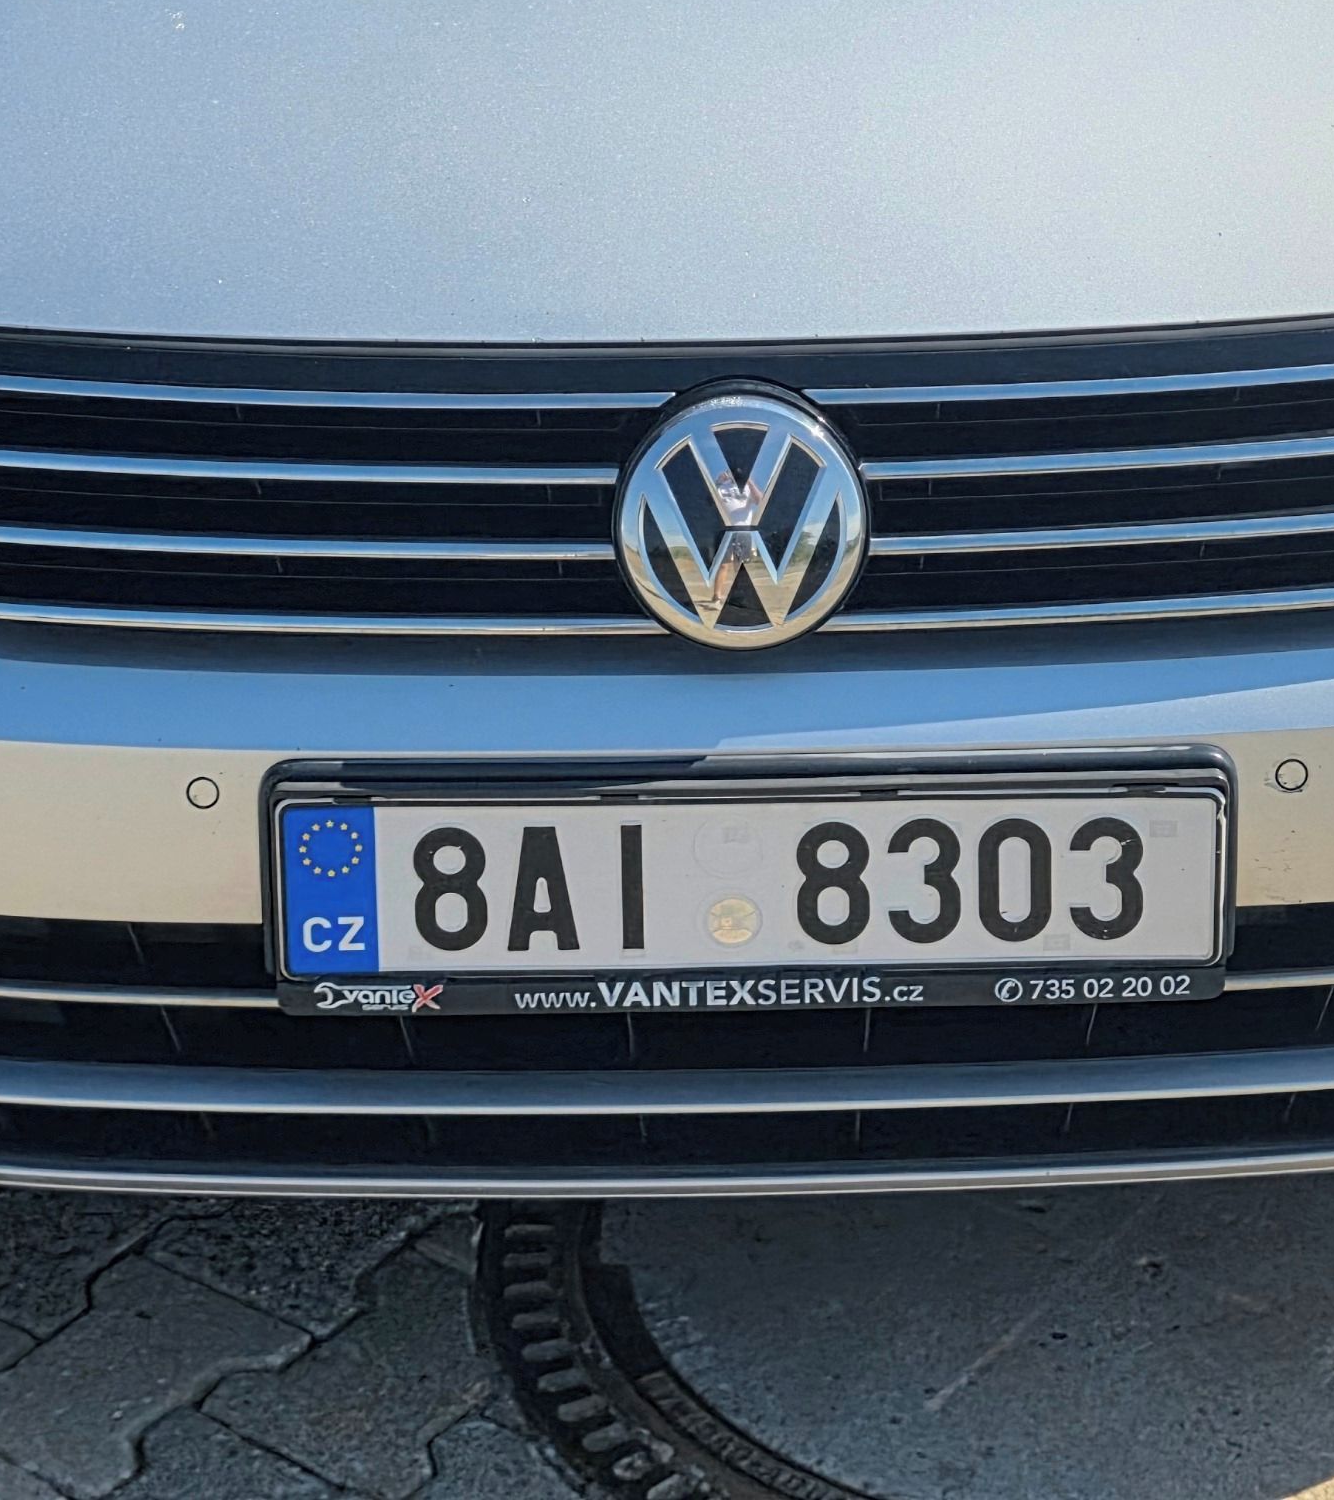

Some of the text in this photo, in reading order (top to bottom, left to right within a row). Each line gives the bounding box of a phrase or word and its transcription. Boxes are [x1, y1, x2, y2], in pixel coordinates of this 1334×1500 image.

[413, 817, 1143, 951] 8AI 8303
[302, 916, 365, 952] CZ
[515, 976, 924, 1009] www.VANTEXSERVIS.cz
[1030, 975, 1191, 999] 735 02 20 02
